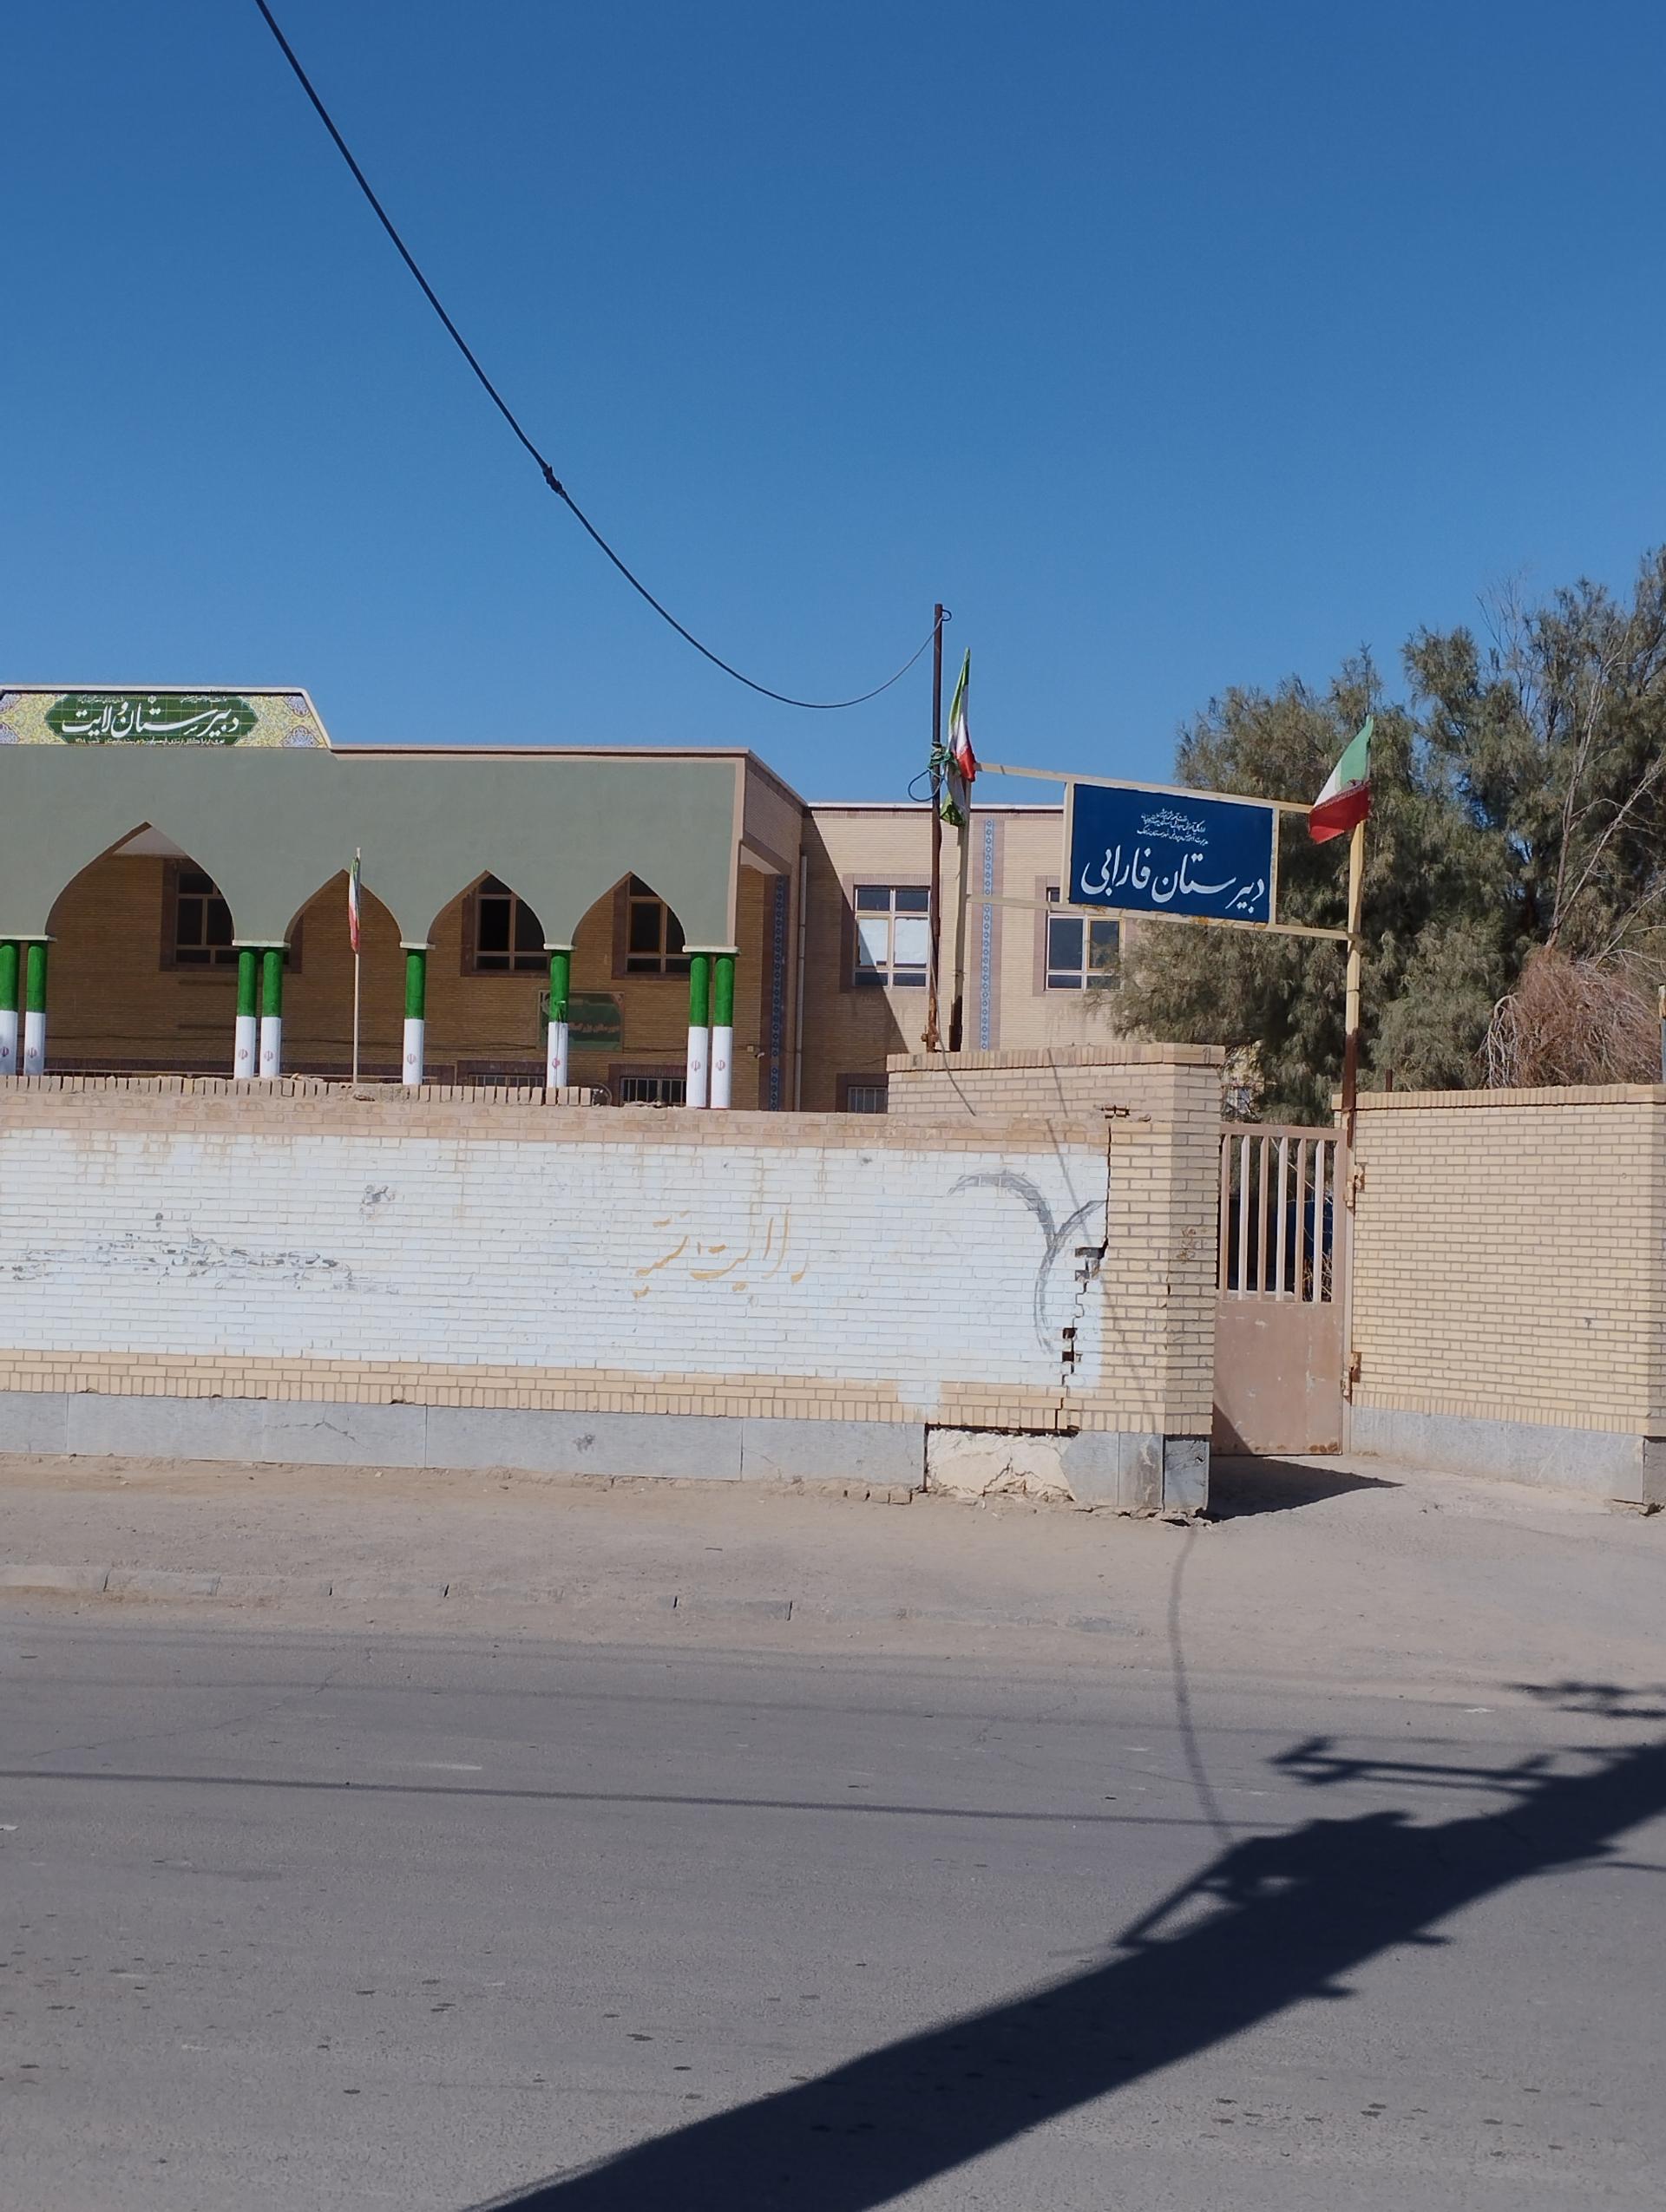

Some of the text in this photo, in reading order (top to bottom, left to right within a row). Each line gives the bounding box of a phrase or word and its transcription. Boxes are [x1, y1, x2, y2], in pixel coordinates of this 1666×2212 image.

[62, 701, 239, 737] دبیرستان ولایت
[1080, 844, 1265, 914] دبیرستان فارابی
